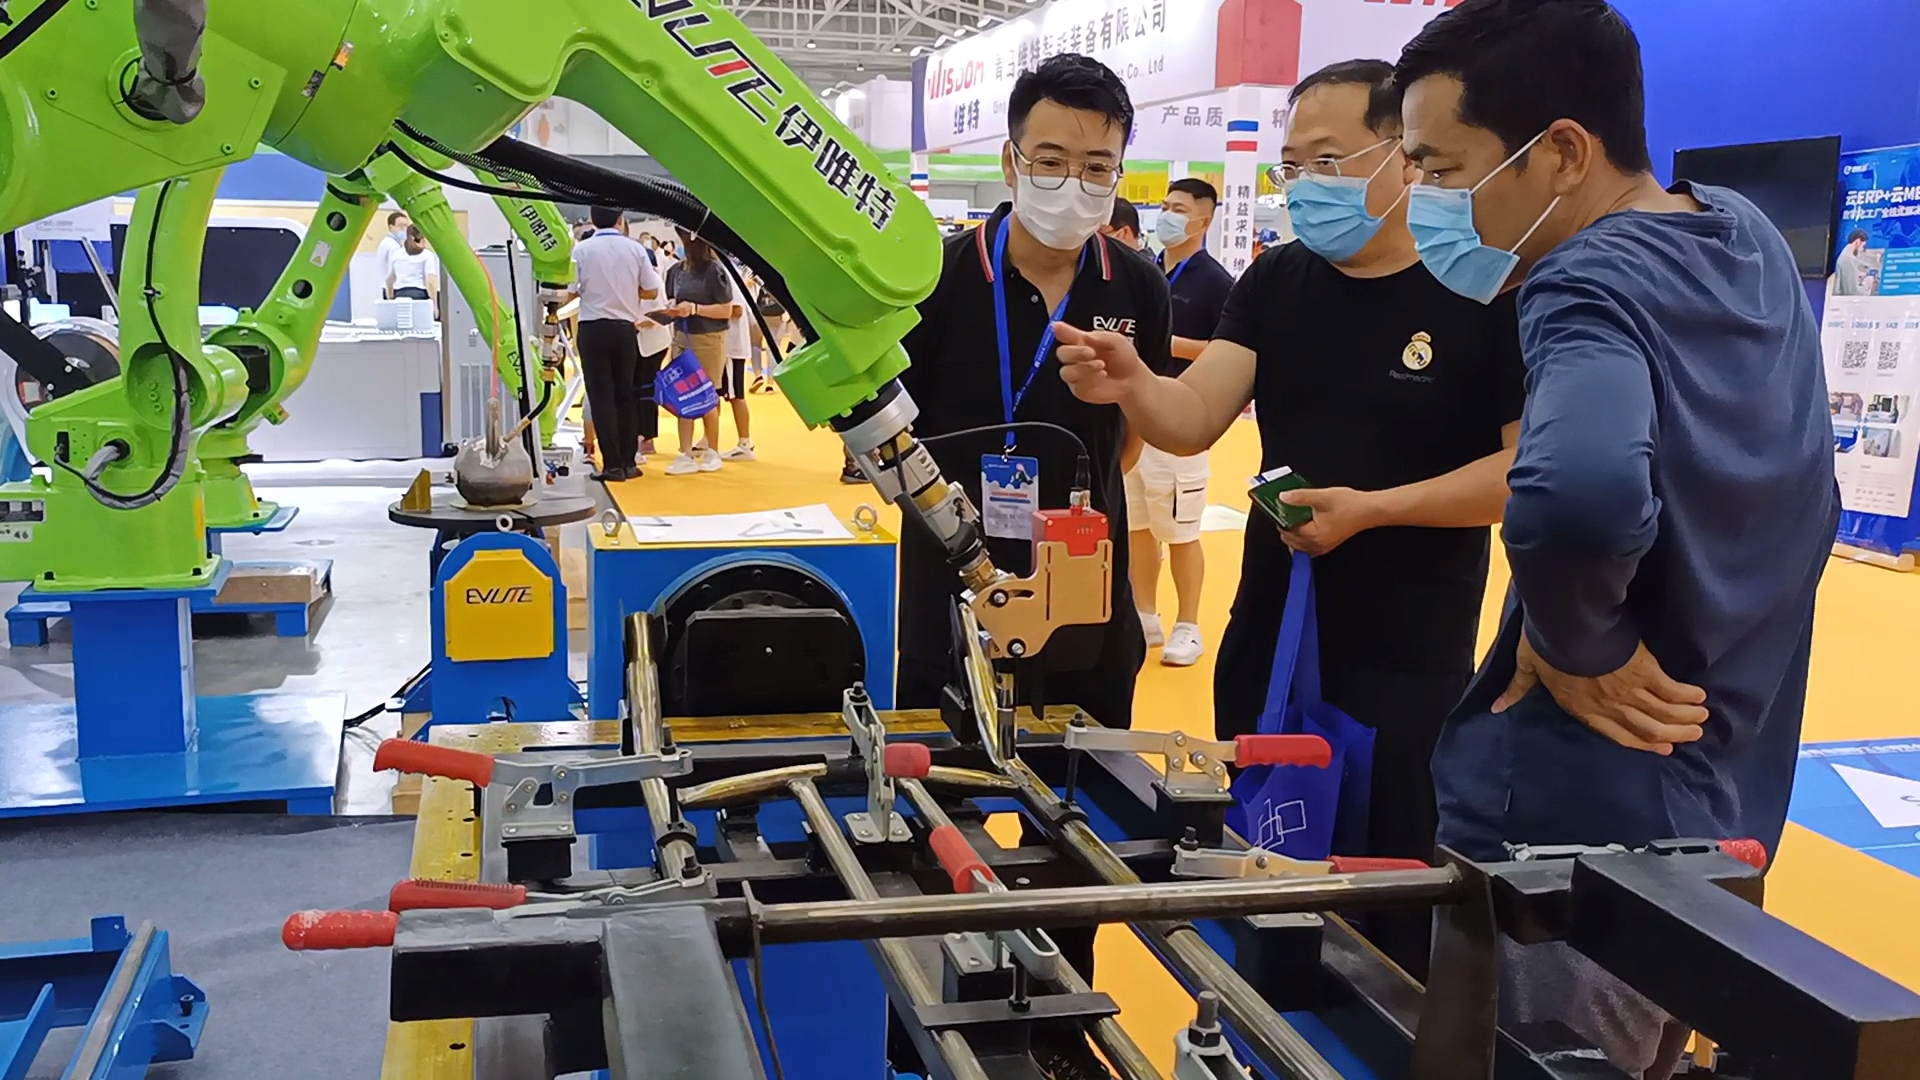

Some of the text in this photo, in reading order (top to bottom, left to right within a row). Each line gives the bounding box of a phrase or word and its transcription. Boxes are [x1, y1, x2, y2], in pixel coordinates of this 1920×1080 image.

[953, 98, 981, 135] 维特
[1161, 105, 1223, 127] 产品质
[773, 104, 898, 231] 伊唯特
[519, 204, 557, 252] 伊唯特
[1235, 185, 1250, 249] 精益求精
